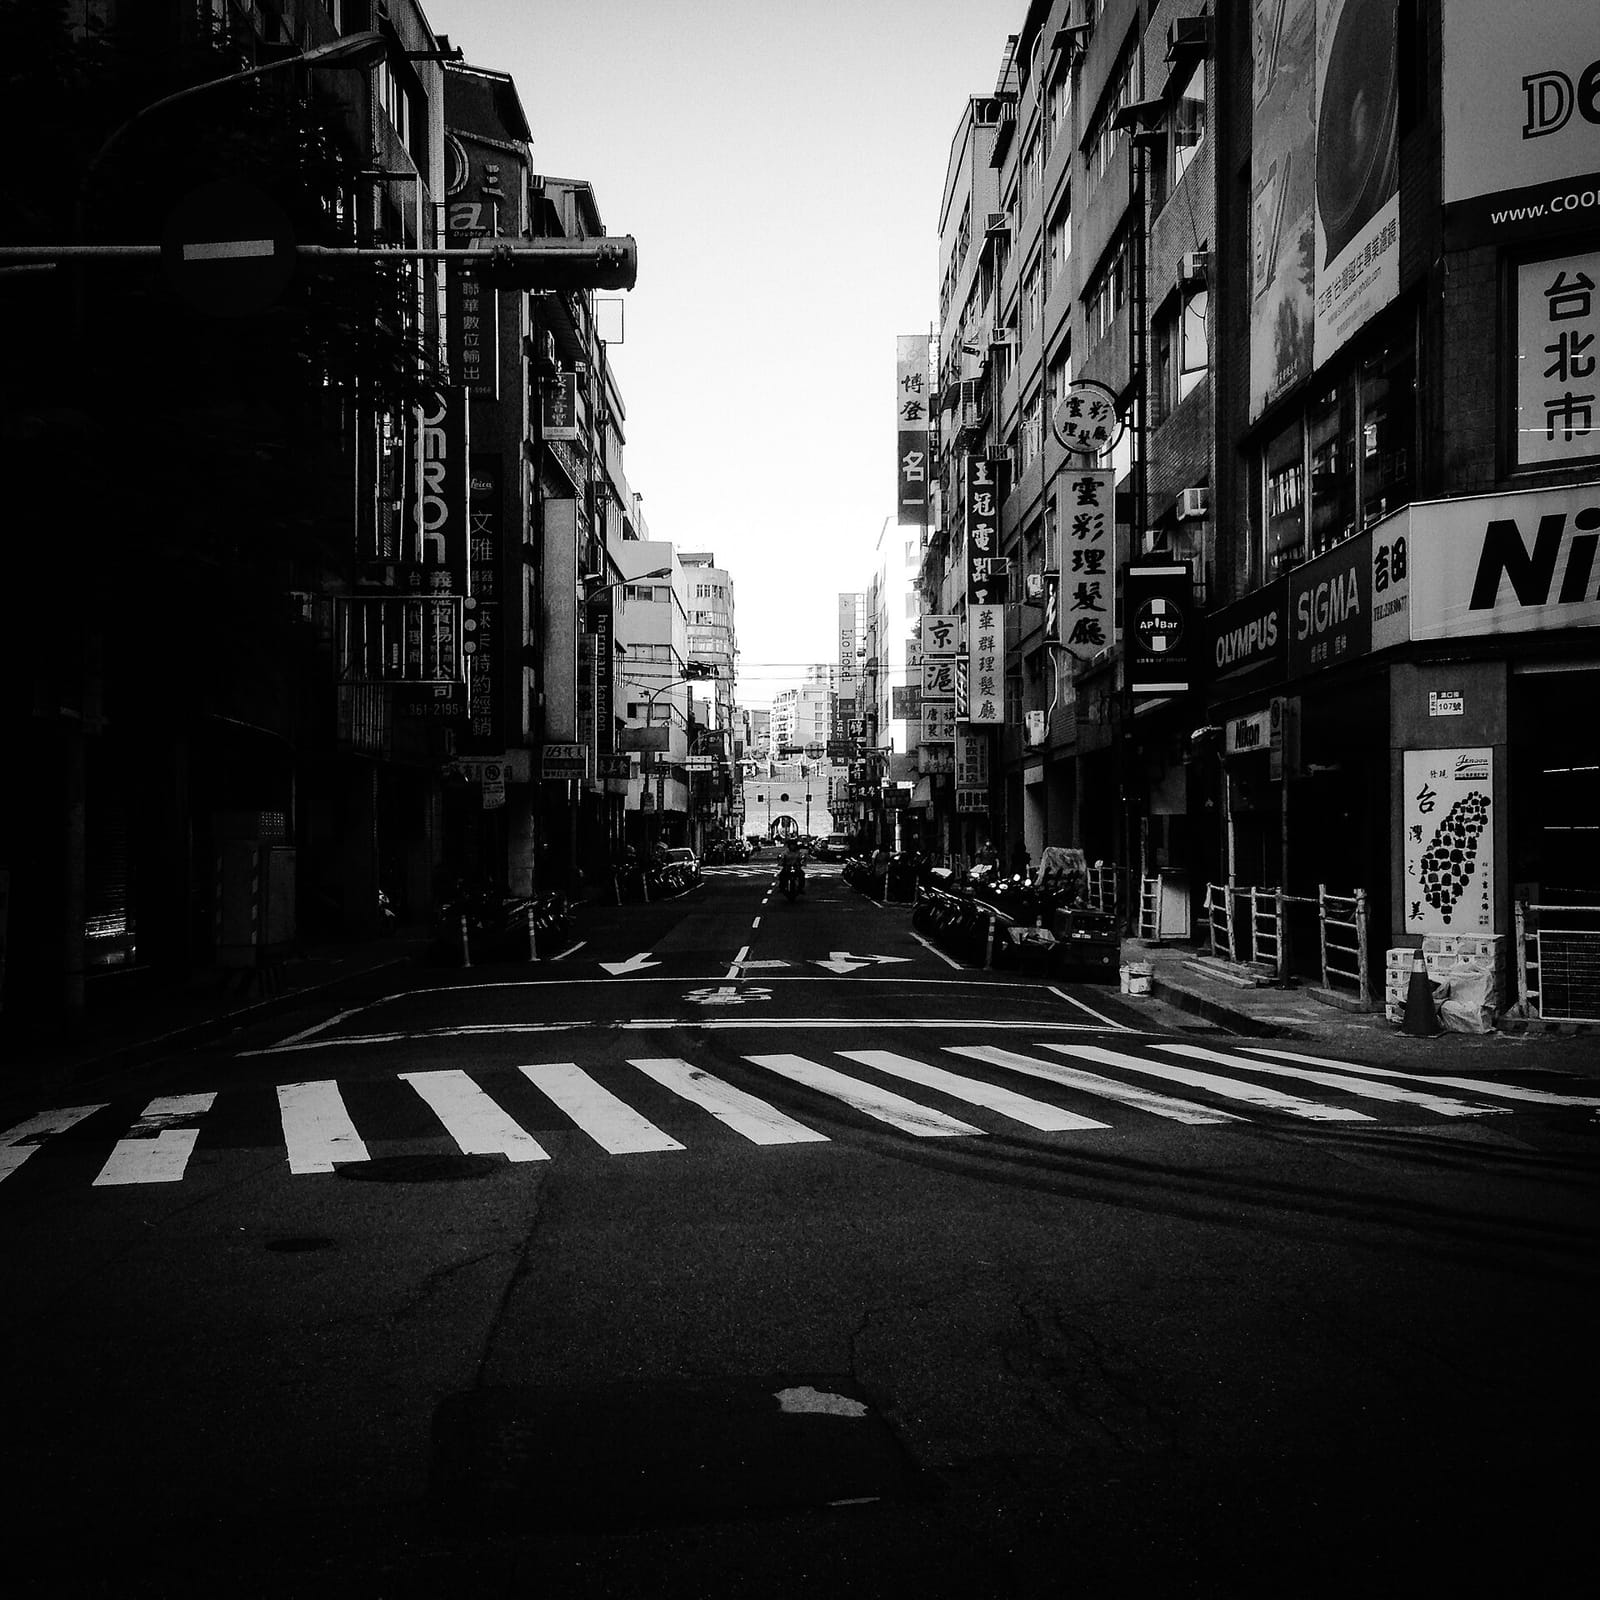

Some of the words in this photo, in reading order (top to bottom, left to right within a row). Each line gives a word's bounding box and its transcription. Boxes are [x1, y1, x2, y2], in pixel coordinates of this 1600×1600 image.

[1490, 189, 1600, 225] www.coo
[1544, 271, 1596, 442] 台北市
[470, 510, 494, 562] 文雅
[1069, 477, 1107, 645] 雲彩理髮廳
[1469, 507, 1600, 611] Ni
[1297, 566, 1361, 641] SIGMA
[597, 614, 609, 677] harman
[1215, 611, 1278, 668] OLYMPUS
[597, 684, 609, 732] kardon
[1234, 718, 1261, 750] Nikon
